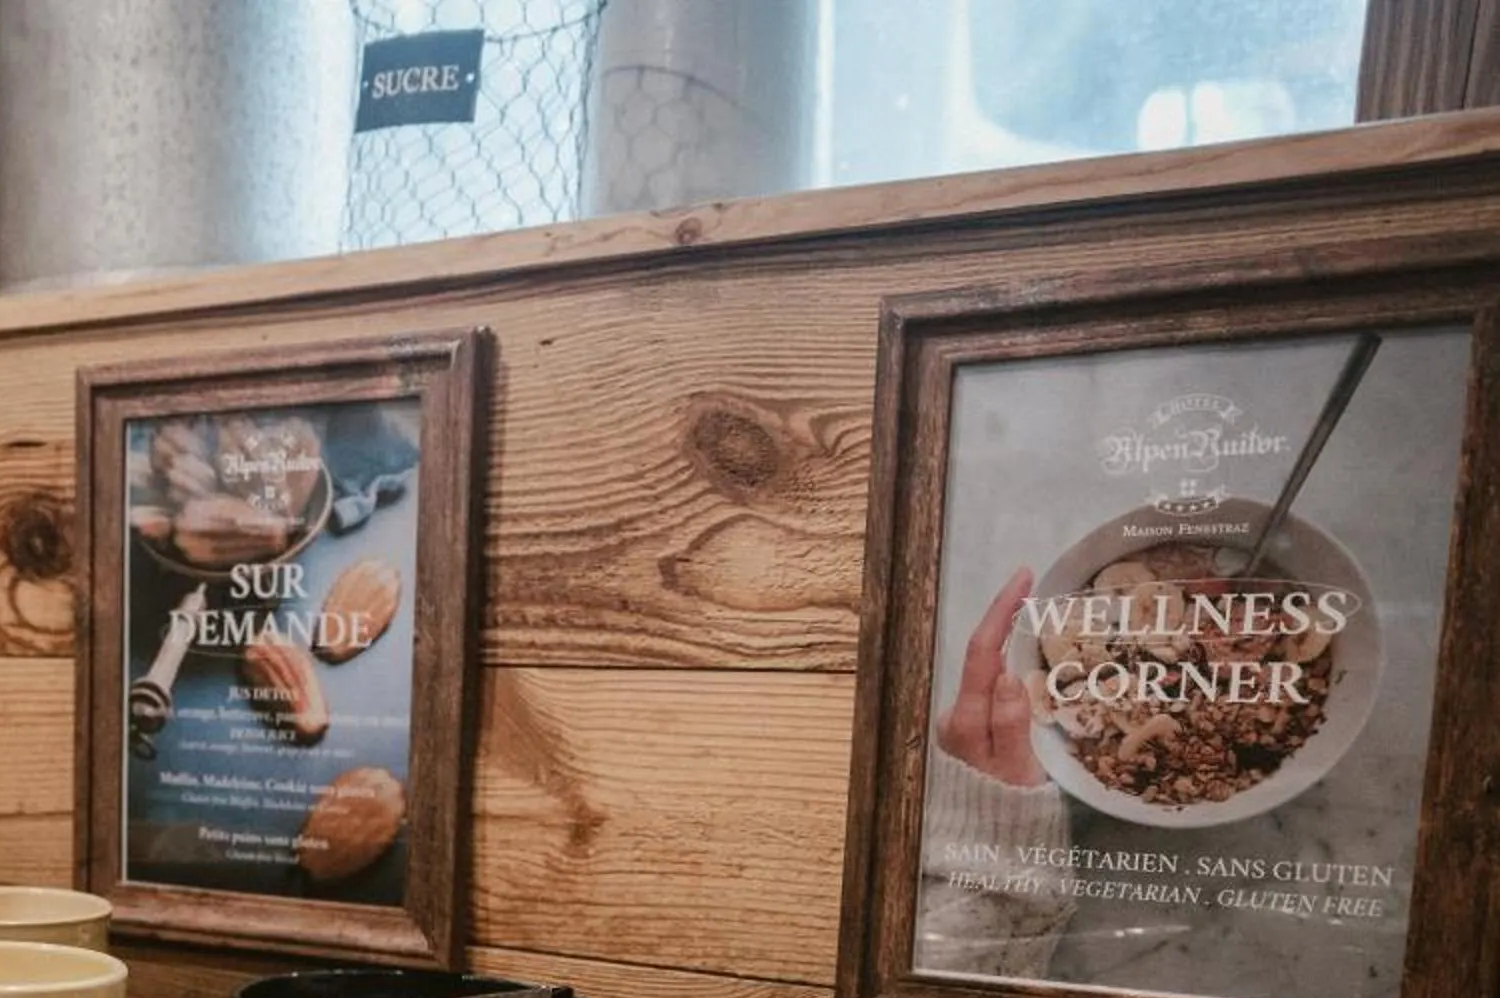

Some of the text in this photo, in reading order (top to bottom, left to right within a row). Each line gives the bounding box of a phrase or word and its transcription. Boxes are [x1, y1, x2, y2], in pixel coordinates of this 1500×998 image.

[372, 64, 460, 99] SUCRE
[230, 562, 308, 599] SUR
[169, 610, 372, 647] DEMANDE
[1023, 591, 1349, 636] WELLNESS
[1047, 660, 1310, 704] CORNER
[945, 841, 1394, 887] SAIN VÉGÉTARIEN SANS GLUTEN
[949, 871, 1384, 917] HEALTHY VEGETARIAN GLUTEN FREE
